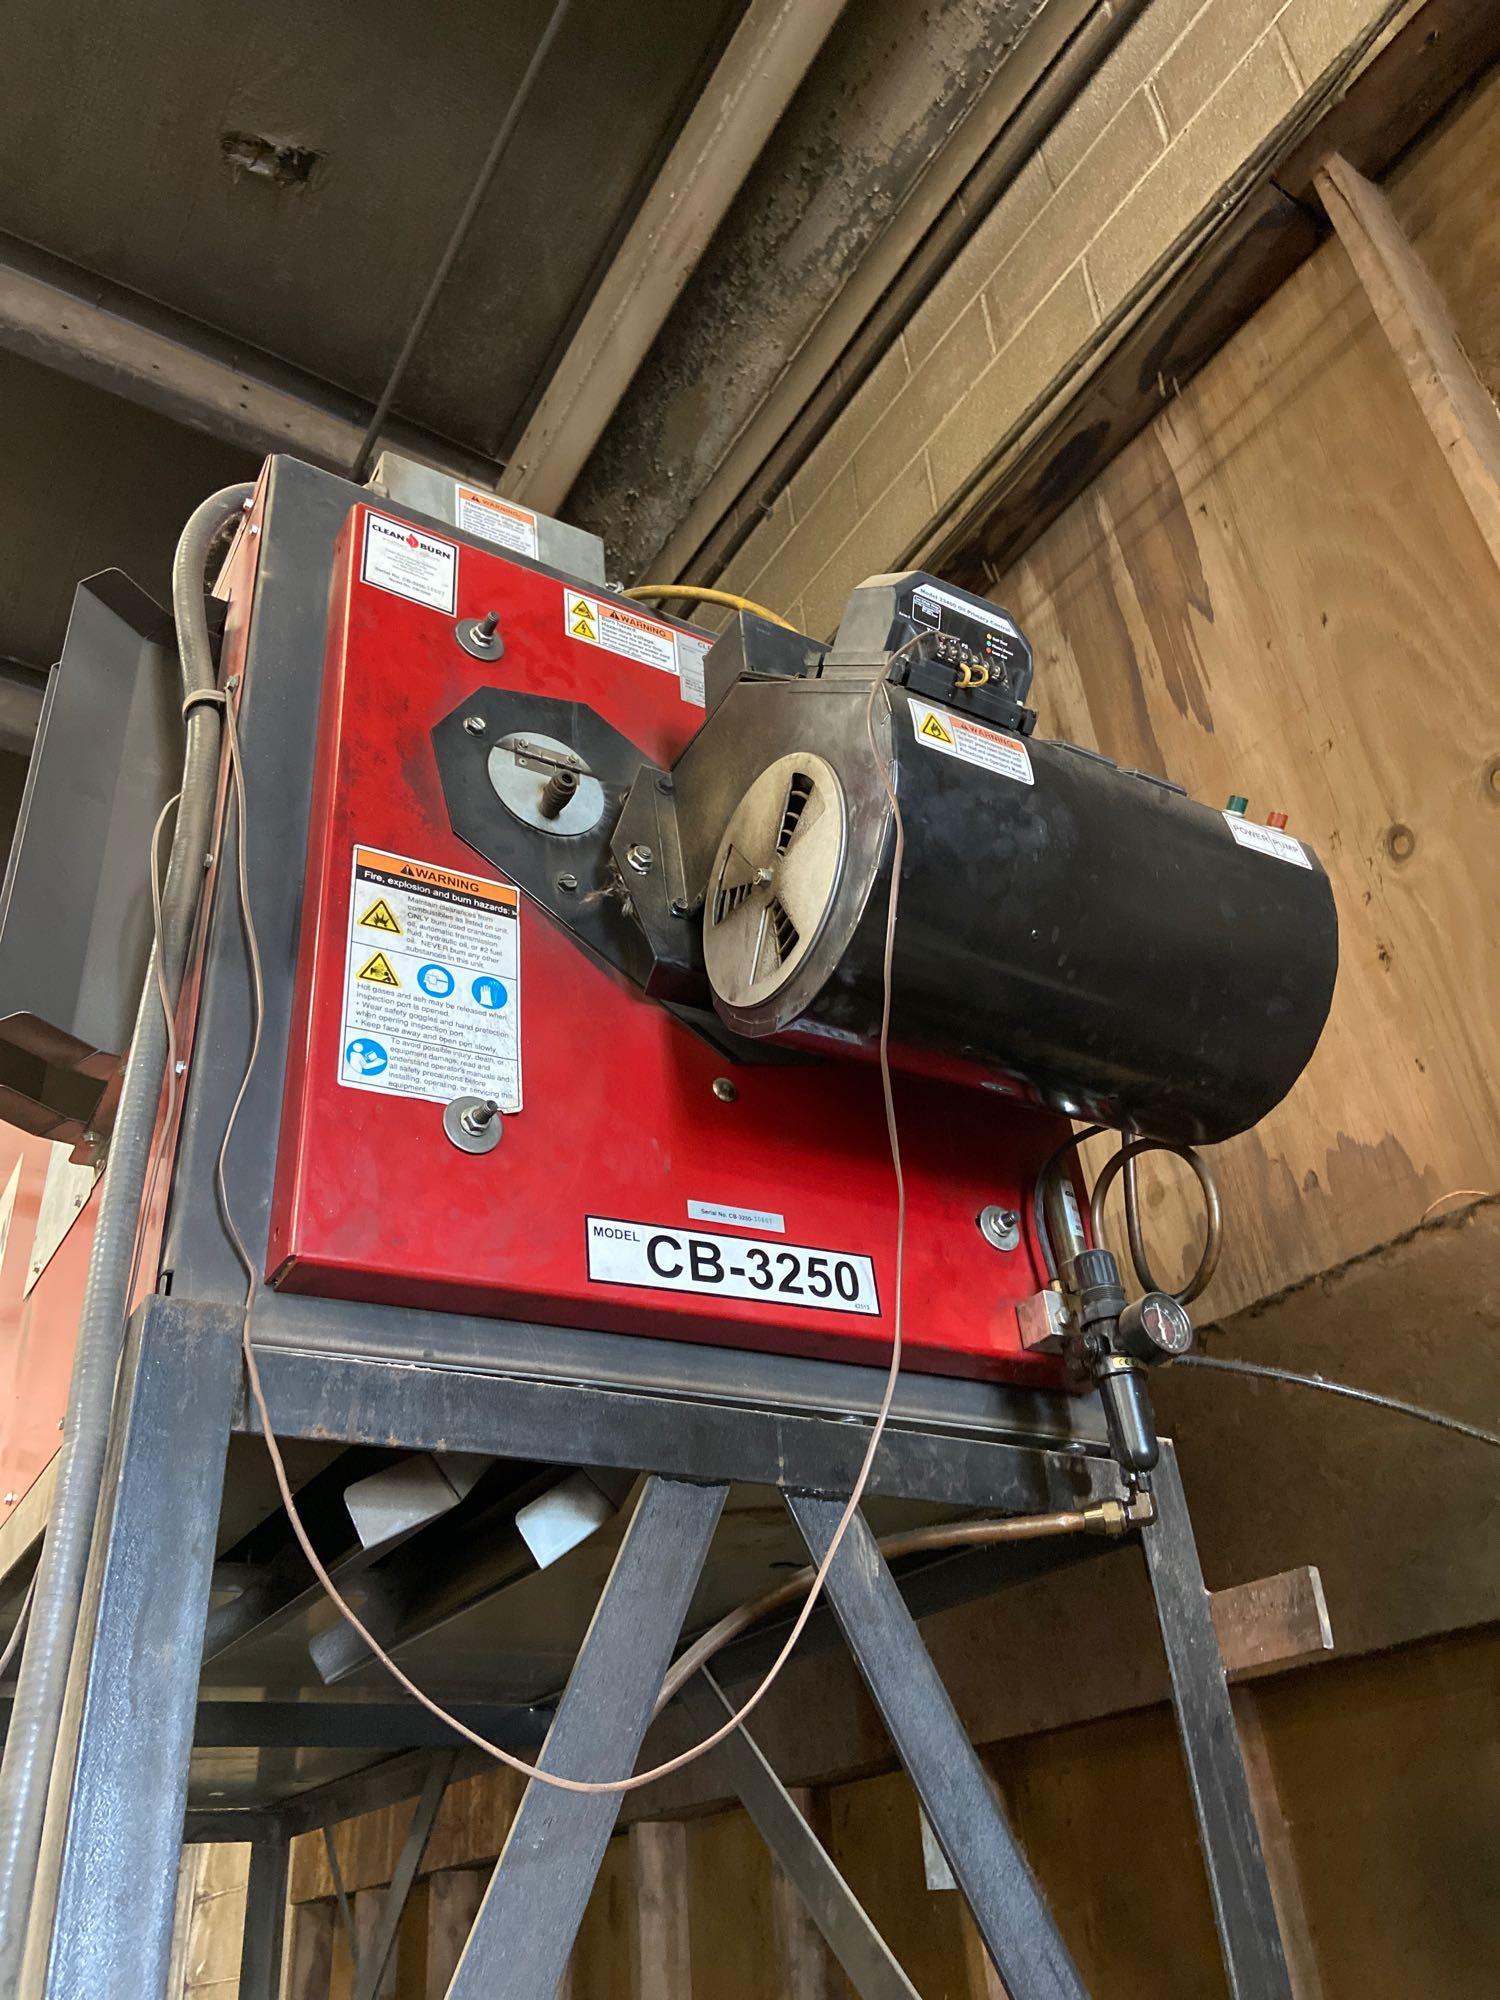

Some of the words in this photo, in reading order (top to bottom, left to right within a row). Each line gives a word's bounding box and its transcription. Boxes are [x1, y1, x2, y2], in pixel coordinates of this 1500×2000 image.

[372, 523, 404, 541] CLEAN
[420, 543, 450, 560] BURN
[920, 588, 938, 600] Model
[602, 617, 615, 625] Burn
[602, 622, 632, 637] Hazardous
[622, 615, 666, 637] WARNING
[1233, 824, 1270, 842] POWER
[1272, 839, 1299, 852] PUMP
[364, 870, 385, 883] Fire,
[388, 877, 431, 896] explosion
[433, 889, 449, 900] and
[452, 893, 471, 905] burn
[416, 868, 479, 893] WARNING
[407, 904, 453, 921] combustibles
[465, 918, 482, 928] listed
[495, 925, 509, 935] unit.
[408, 896, 438, 909] Maintain
[440, 904, 476, 918] clearances
[478, 913, 493, 922] from
[407, 912, 428, 923] ONLY
[431, 918, 447, 927] burn
[449, 922, 465, 932] used
[467, 927, 501, 940] crankcase
[407, 920, 417, 929] oil,
[419, 923, 453, 937] automatic
[455, 931, 497, 947] transmission
[406, 936, 417, 945] oil.
[421, 940, 448, 952] NEVER
[450, 947, 465, 956] burn
[468, 953, 480, 961] any
[482, 955, 499, 964] other
[407, 928, 423, 939] fluid,
[426, 933, 457, 947] hydraulic
[459, 941, 469, 950] oil,
[480, 946, 488, 954] #2
[490, 948, 502, 957] fuel
[406, 944, 446, 959] substances
[457, 956, 468, 965] this
[470, 959, 483, 968] unit.
[357, 983, 371, 991] Hot
[373, 986, 395, 998] gases
[398, 991, 411, 1000] and
[413, 994, 427, 1003] ash
[429, 999, 443, 1009] may
[446, 1002, 455, 1010] be
[456, 1004, 487, 1017] released
[489, 1011, 507, 1021] when
[357, 992, 394, 1007] inspection
[397, 1000, 411, 1010] port
[421, 1006, 449, 1018] opened.
[356, 1010, 376, 1020] when
[379, 1014, 408, 1028] opening
[410, 1021, 447, 1036] inspection
[362, 1002, 382, 1012] Wear
[384, 1006, 407, 1018] safety
[409, 1012, 437, 1025] goggles
[440, 1018, 453, 1027] and
[456, 1021, 472, 1031] hand
[361, 1020, 381, 1031] Keep
[383, 1024, 399, 1033] face
[401, 1028, 421, 1039] away
[423, 1032, 436, 1041] and
[439, 1036, 457, 1046] open
[459, 1040, 472, 1050] port
[390, 1046, 427, 1060] equipment
[461, 1060, 476, 1068] read
[478, 1063, 490, 1071] and
[392, 1037, 400, 1045] To
[402, 1039, 421, 1049] avoid
[423, 1044, 451, 1056] possible
[453, 1050, 472, 1061] injury,
[475, 1054, 495, 1064] death,
[389, 1062, 398, 1070] all
[399, 1065, 420, 1076] safety
[422, 1069, 463, 1084] precautions
[465, 1077, 485, 1087] before
[390, 1054, 429, 1068] understand
[431, 1062, 465, 1076] operator's
[467, 1069, 495, 1080] manuals
[497, 1074, 509, 1083] and
[389, 1071, 420, 1085] installing,
[424, 1078, 457, 1092] operating,
[470, 1086, 499, 1099] servicing
[501, 1091, 513, 1100] this
[701, 1208, 717, 1216] Serial
[593, 1226, 640, 1242] MODEL
[646, 1234, 860, 1301] CB-3250
